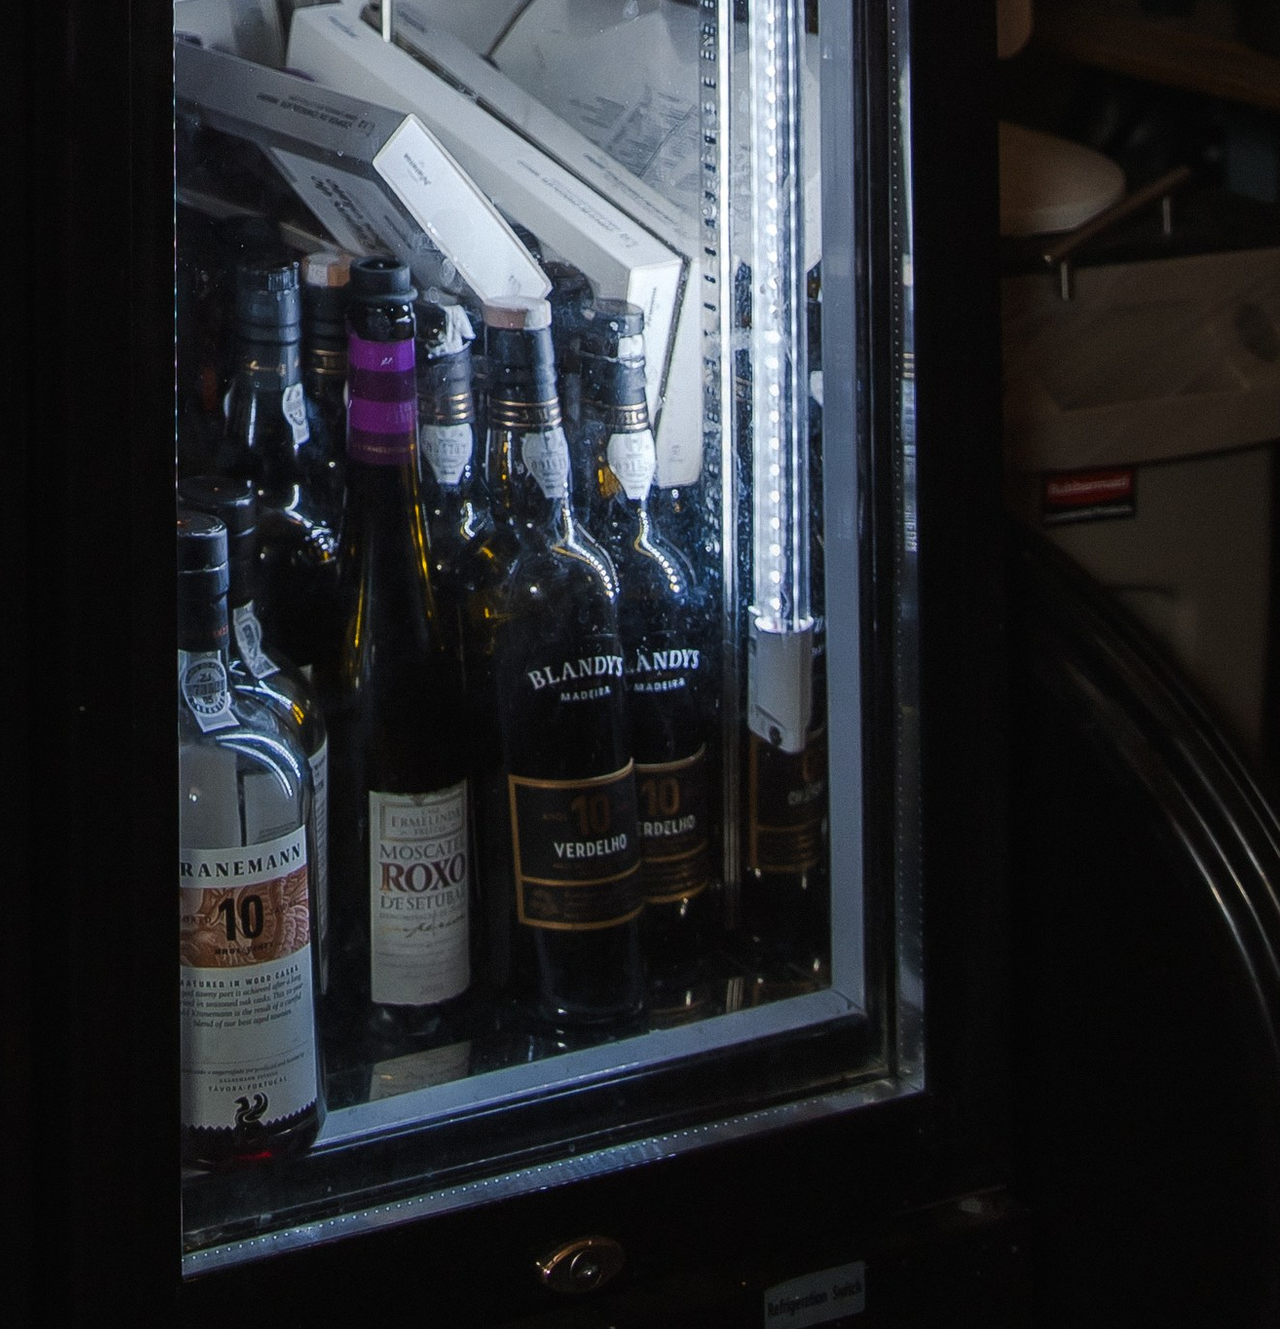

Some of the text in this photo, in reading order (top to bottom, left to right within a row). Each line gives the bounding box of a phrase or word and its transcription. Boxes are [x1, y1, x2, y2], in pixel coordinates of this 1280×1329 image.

[561, 685, 613, 702] MADEIRA
[634, 677, 687, 693] MADEIRA
[642, 778, 681, 816] 10
[570, 792, 612, 836] 10
[181, 842, 301, 879] RANEMANN
[553, 833, 628, 859] VERDELHO
[380, 850, 466, 893] ROXO
[217, 894, 264, 942] 10
[229, 979, 240, 988] IN
[245, 974, 271, 986] WOOD
[767, 1291, 828, 1317] Refrigeration
